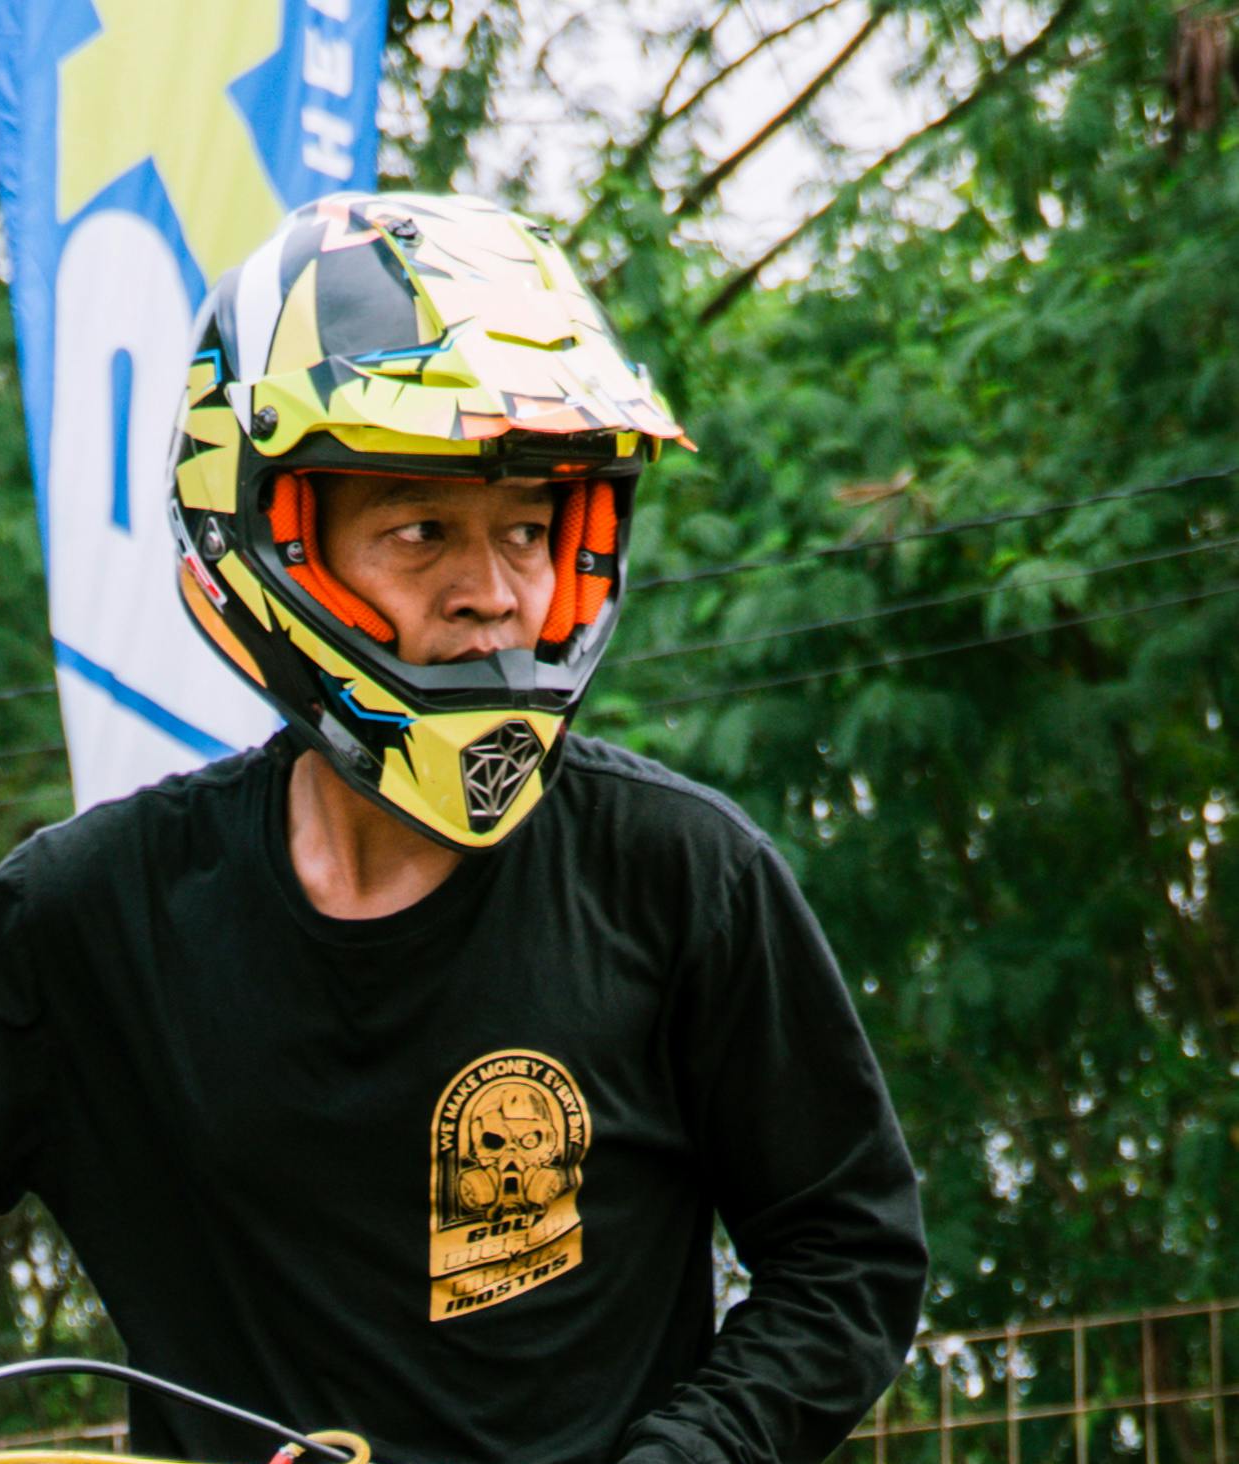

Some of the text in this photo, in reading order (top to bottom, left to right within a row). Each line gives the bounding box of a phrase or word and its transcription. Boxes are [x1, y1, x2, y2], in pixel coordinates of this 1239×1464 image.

[479, 1058, 544, 1081] MONEY
[443, 1073, 481, 1120] MAKE
[440, 1121, 456, 1151] WE
